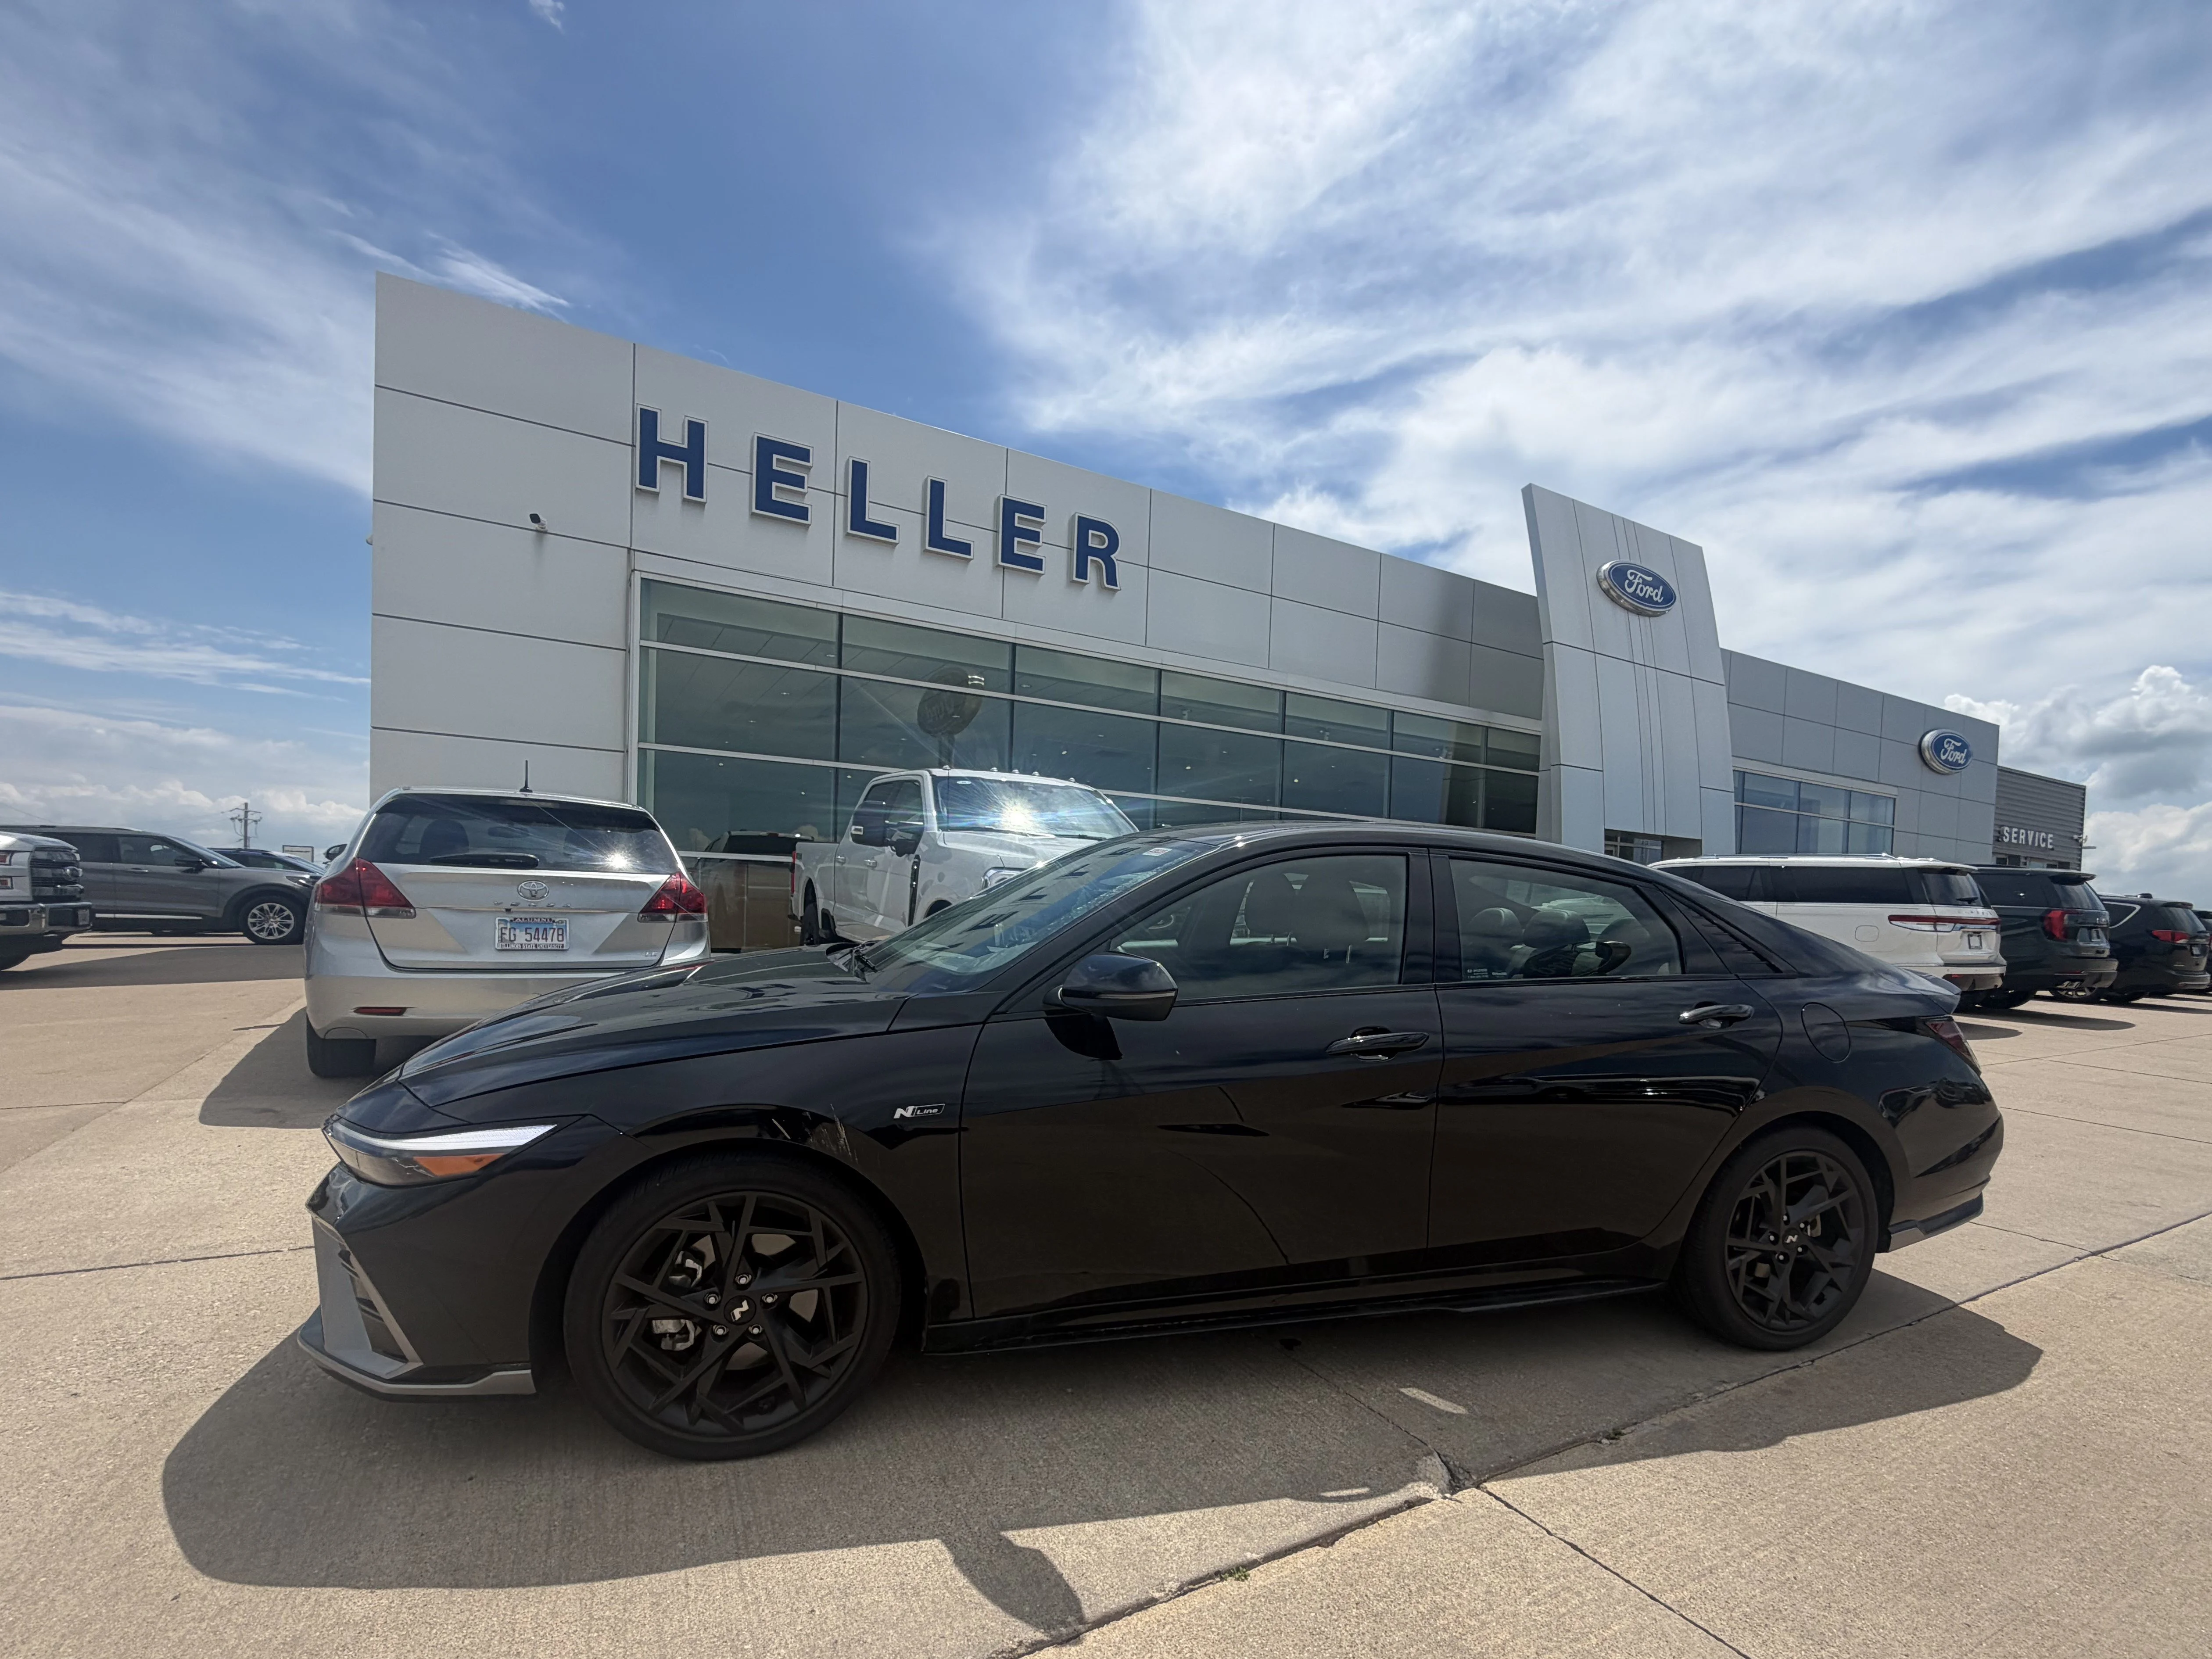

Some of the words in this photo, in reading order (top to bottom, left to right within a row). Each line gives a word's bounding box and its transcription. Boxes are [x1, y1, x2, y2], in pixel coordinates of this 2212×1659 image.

[636, 403, 1122, 592] HELLER
[1624, 569, 1664, 603] Ford
[1940, 738, 1967, 764] Ford
[2003, 826, 2054, 849] SERVICE
[500, 927, 516, 942] FG
